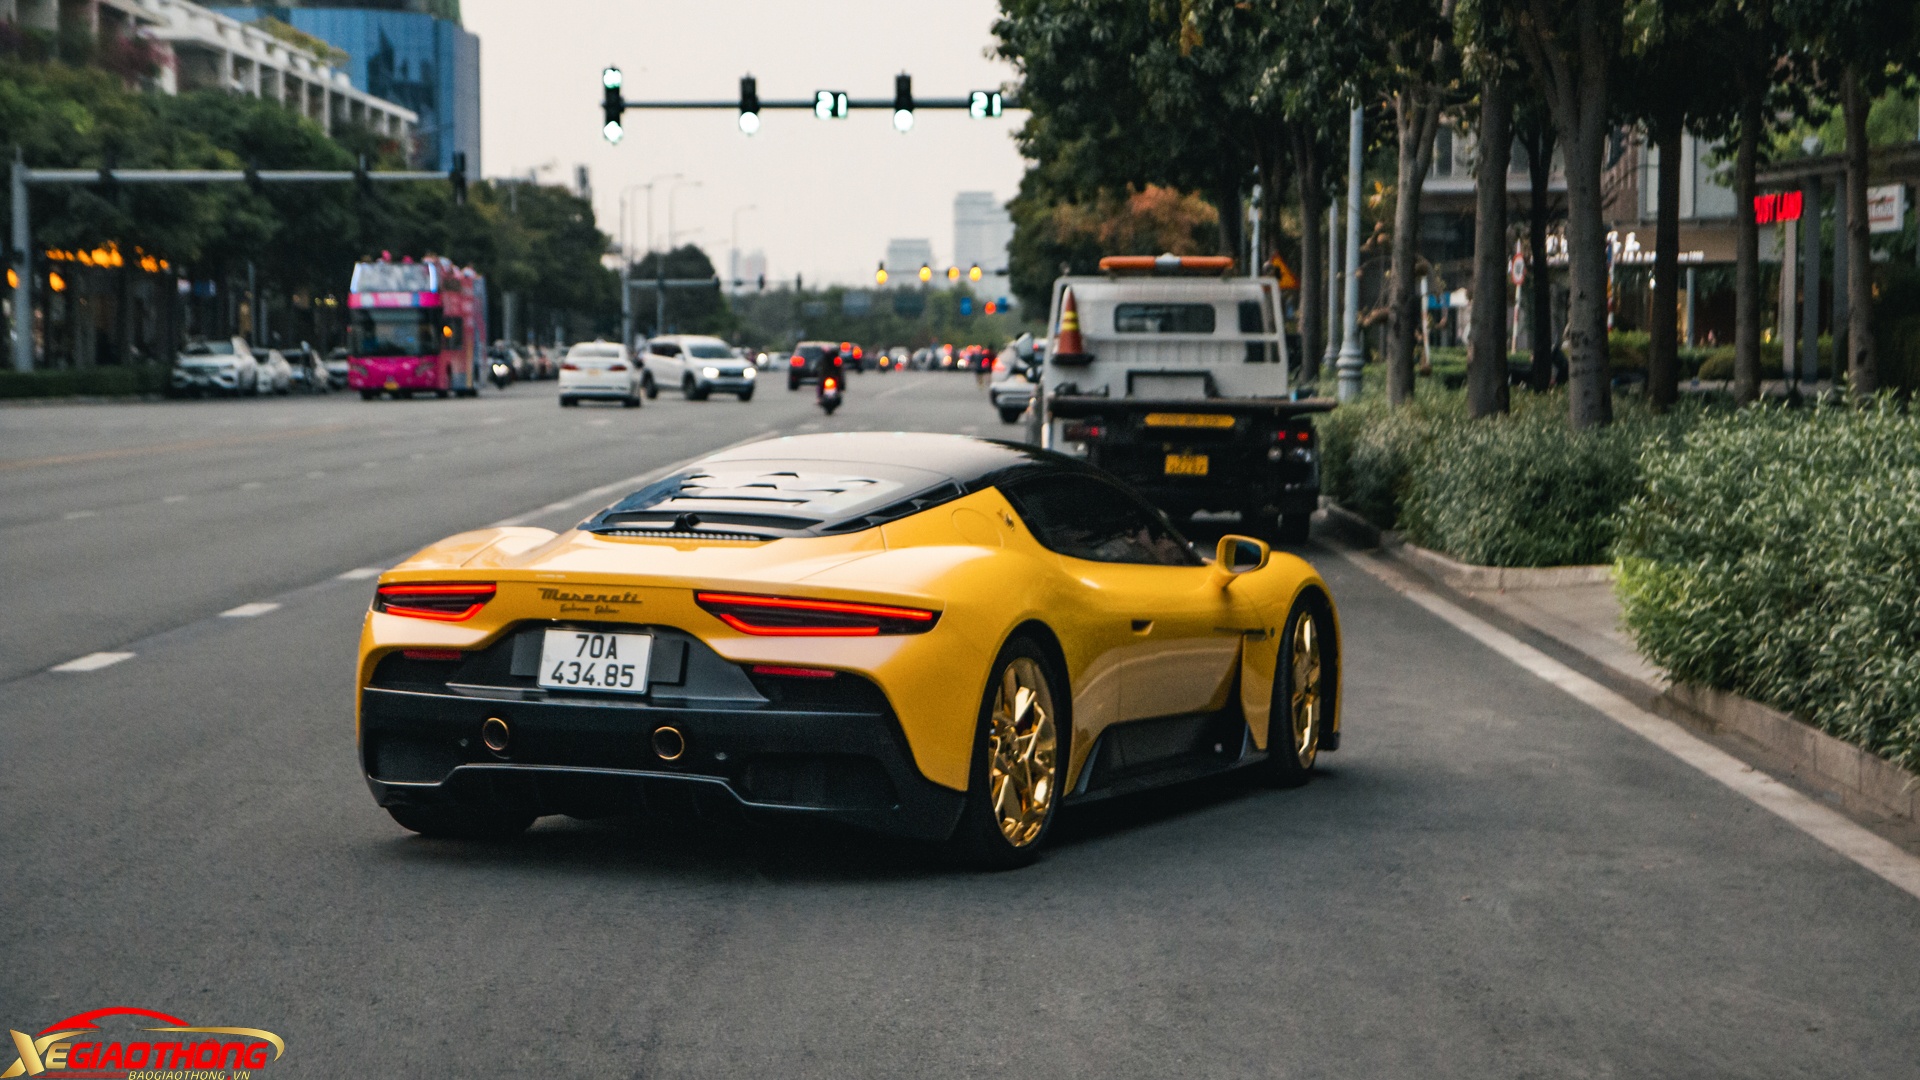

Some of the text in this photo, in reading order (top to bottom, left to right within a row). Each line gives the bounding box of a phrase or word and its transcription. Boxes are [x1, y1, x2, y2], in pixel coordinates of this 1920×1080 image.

[816, 91, 847, 119] 21
[970, 91, 1002, 118] 21
[538, 587, 642, 604] Maserati
[576, 634, 617, 659] 70A
[551, 660, 635, 688] 434.85
